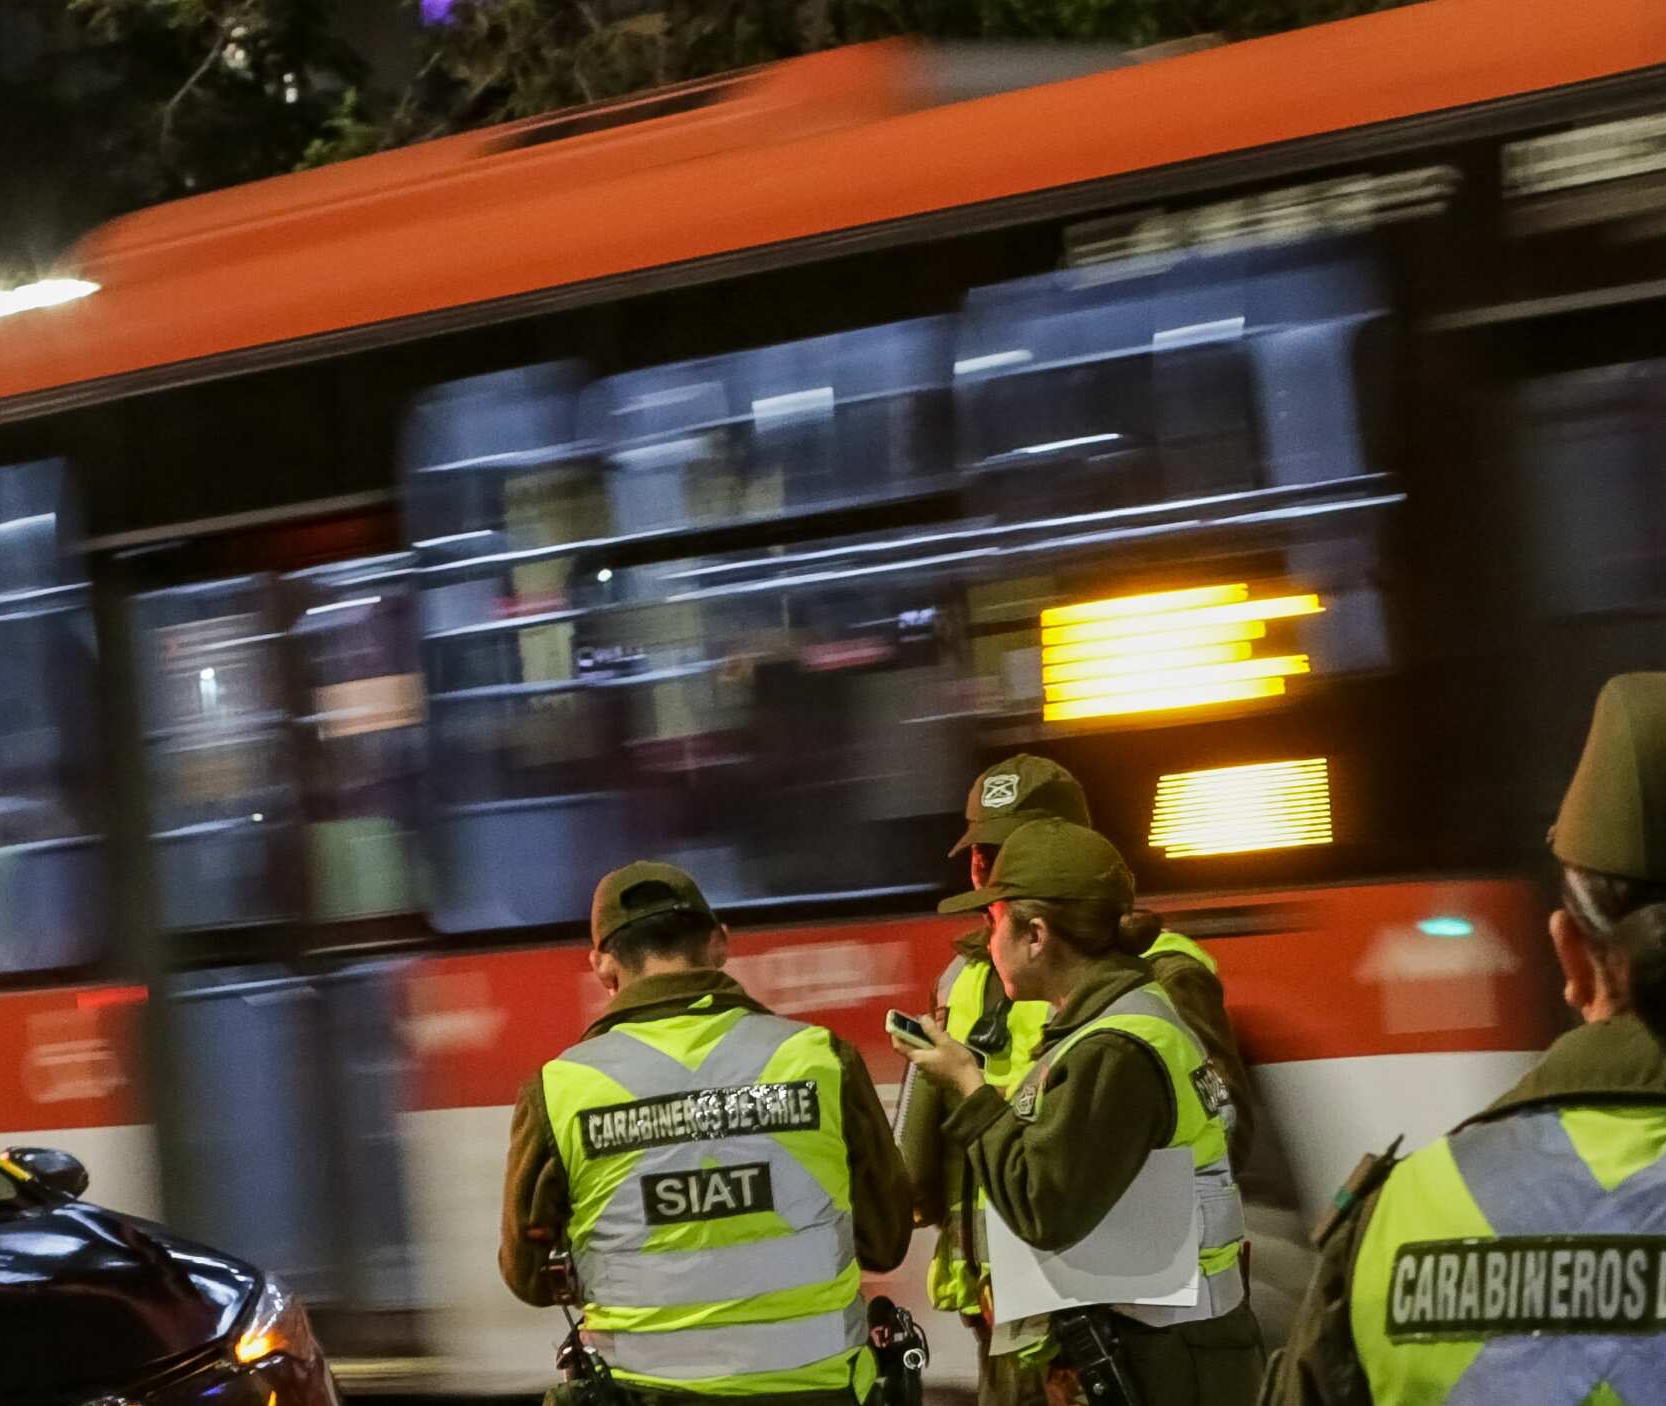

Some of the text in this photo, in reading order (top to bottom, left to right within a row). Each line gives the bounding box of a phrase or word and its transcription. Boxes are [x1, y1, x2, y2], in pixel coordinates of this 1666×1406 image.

[589, 1085, 813, 1148] CARABINEROS DE CHILE
[655, 1167, 760, 1217] SIAT
[1391, 1248, 1648, 1324] CARABINEROS
